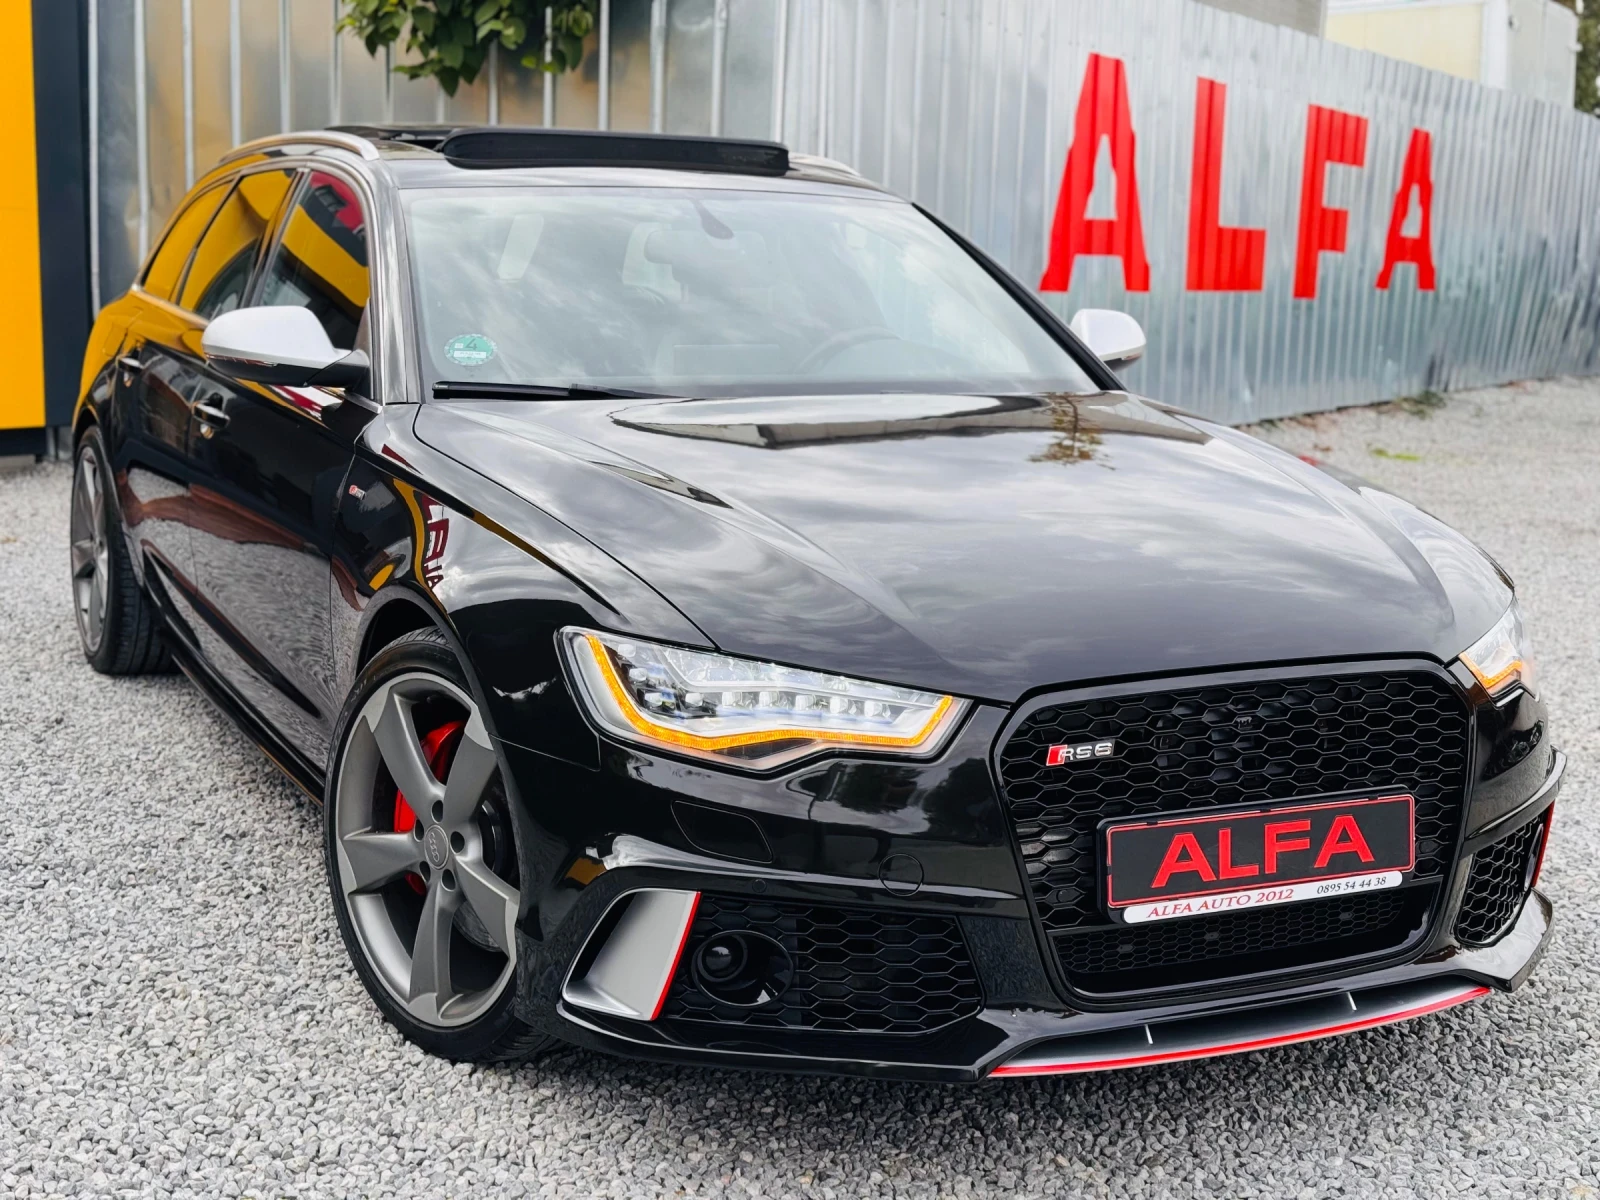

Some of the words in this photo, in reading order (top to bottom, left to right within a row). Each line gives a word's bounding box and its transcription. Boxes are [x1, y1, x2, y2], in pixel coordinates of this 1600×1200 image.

[1038, 52, 1436, 300] ALFA
[464, 338, 478, 351] 4
[1057, 742, 1113, 762] RS6
[1150, 815, 1375, 888] ALFA
[1146, 903, 1193, 918] ALFA
[1198, 894, 1252, 911] AUTO
[1254, 888, 1294, 904] 2012
[1316, 882, 1342, 895] 0895
[1343, 880, 1357, 891] 54
[1358, 878, 1373, 888] 44
[1374, 876, 1387, 886] 38
